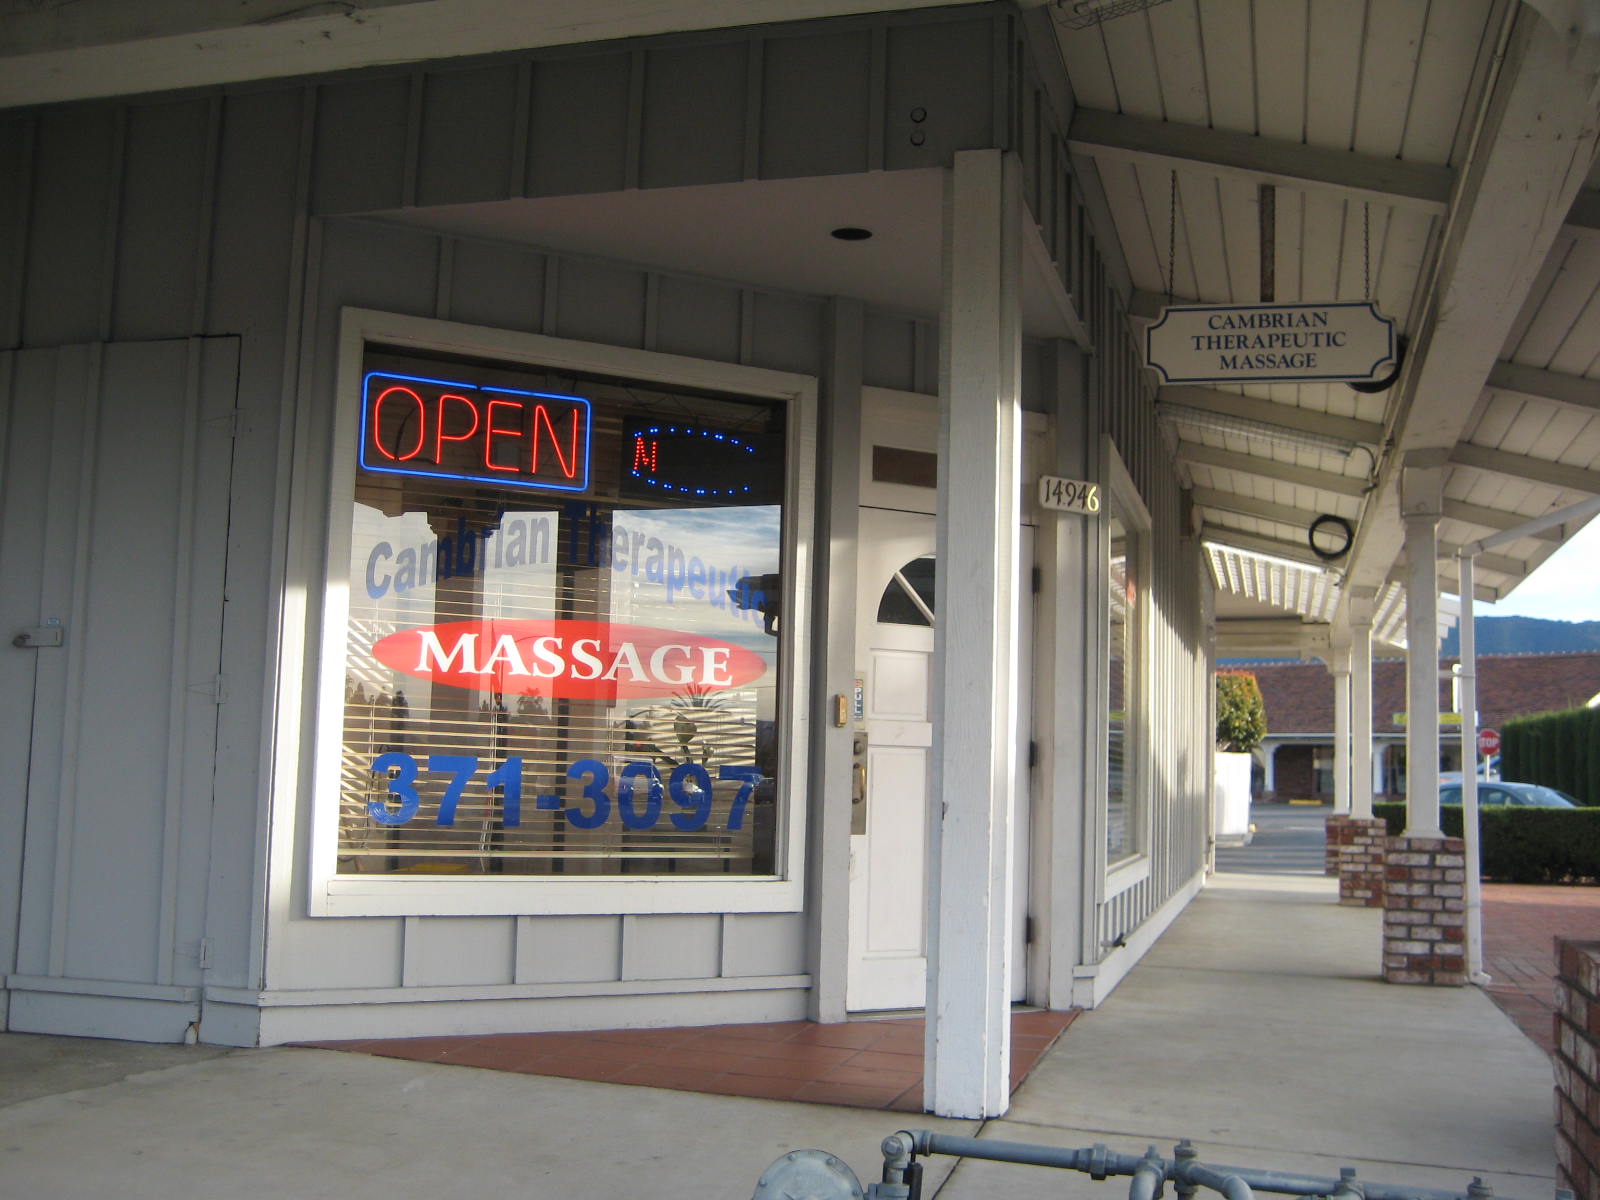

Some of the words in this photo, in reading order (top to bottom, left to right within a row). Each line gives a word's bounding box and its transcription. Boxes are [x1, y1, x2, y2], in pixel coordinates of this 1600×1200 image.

[1208, 311, 1329, 330] CAMBRIAN
[1191, 331, 1347, 351] THERAPEUTIC
[1219, 353, 1318, 370] MASSAGE
[374, 386, 579, 479] OPEN
[1045, 479, 1100, 512] 14946
[366, 508, 550, 599] Cambrian
[566, 502, 768, 629] Therapeutic
[414, 630, 733, 686] MASSAGE
[1479, 736, 1499, 748] STOP
[367, 751, 763, 831] 371-3097
